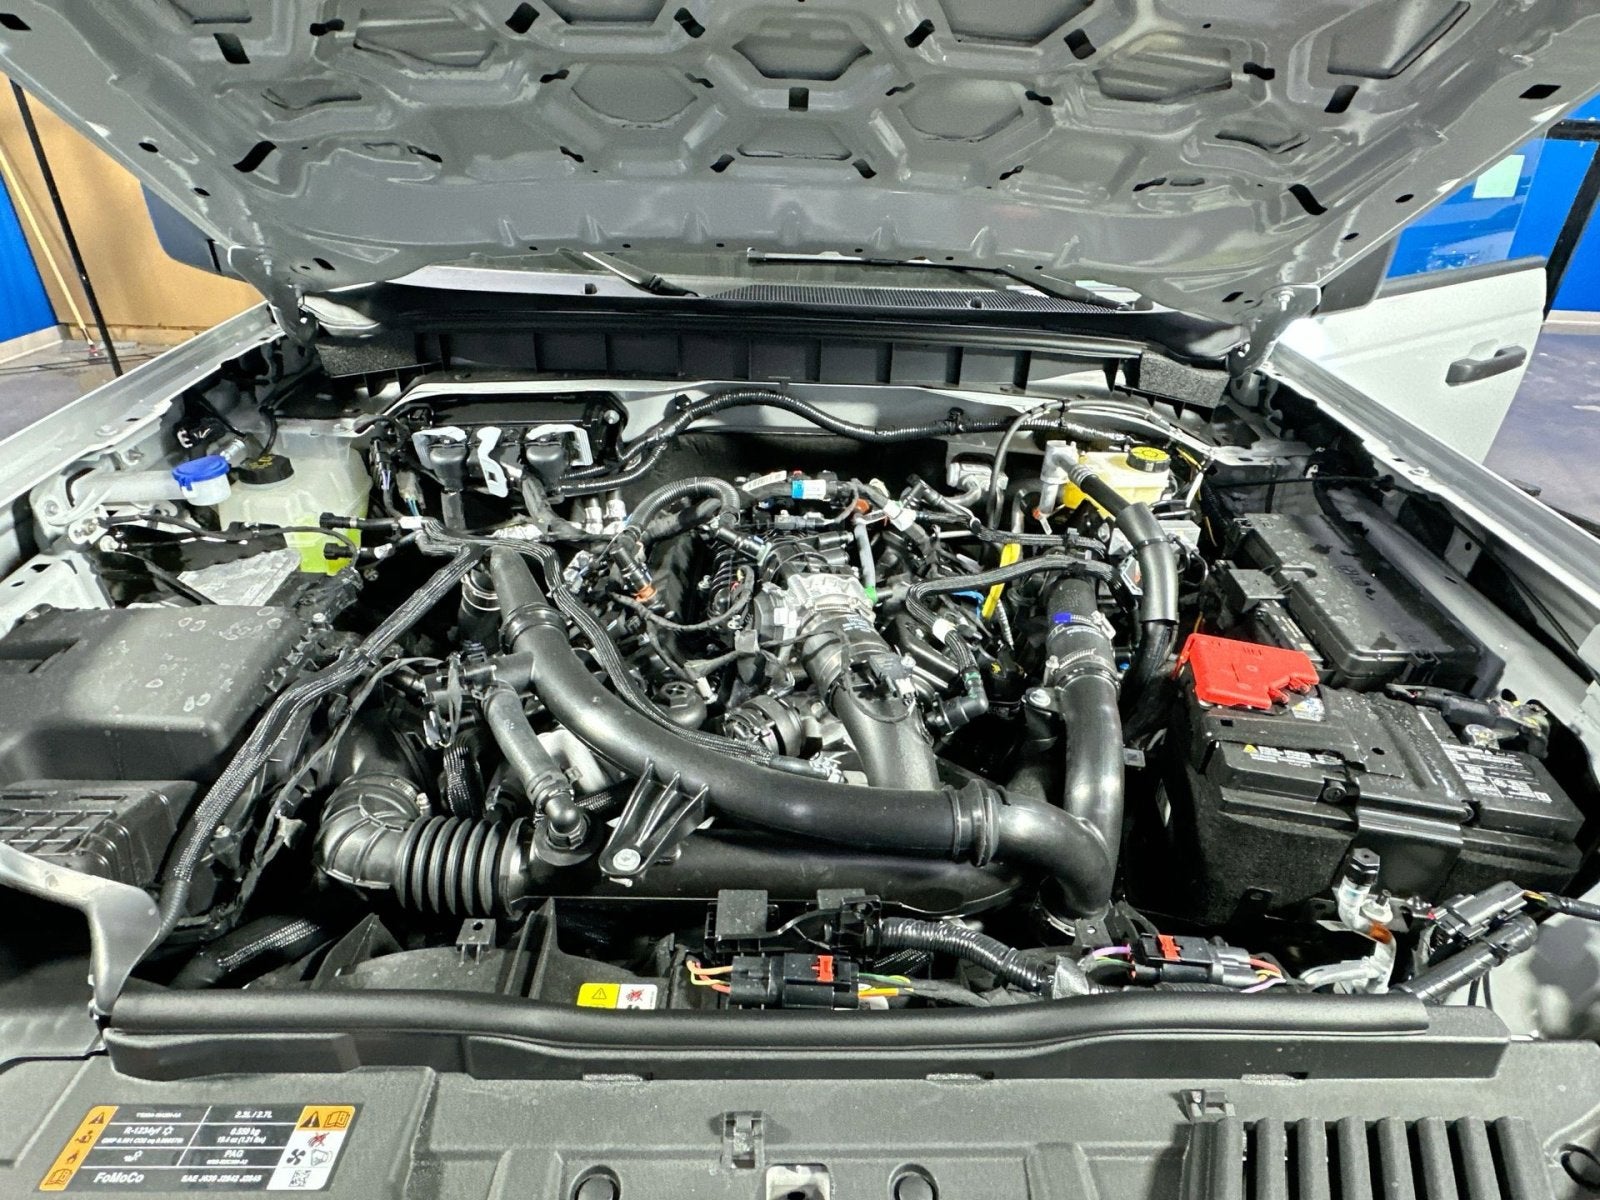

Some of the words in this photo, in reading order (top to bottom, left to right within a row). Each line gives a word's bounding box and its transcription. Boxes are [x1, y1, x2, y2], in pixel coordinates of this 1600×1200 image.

[123, 1126, 162, 1136] R-1234yf
[224, 1150, 244, 1158] PAG
[93, 1171, 145, 1184] FoMoCo
